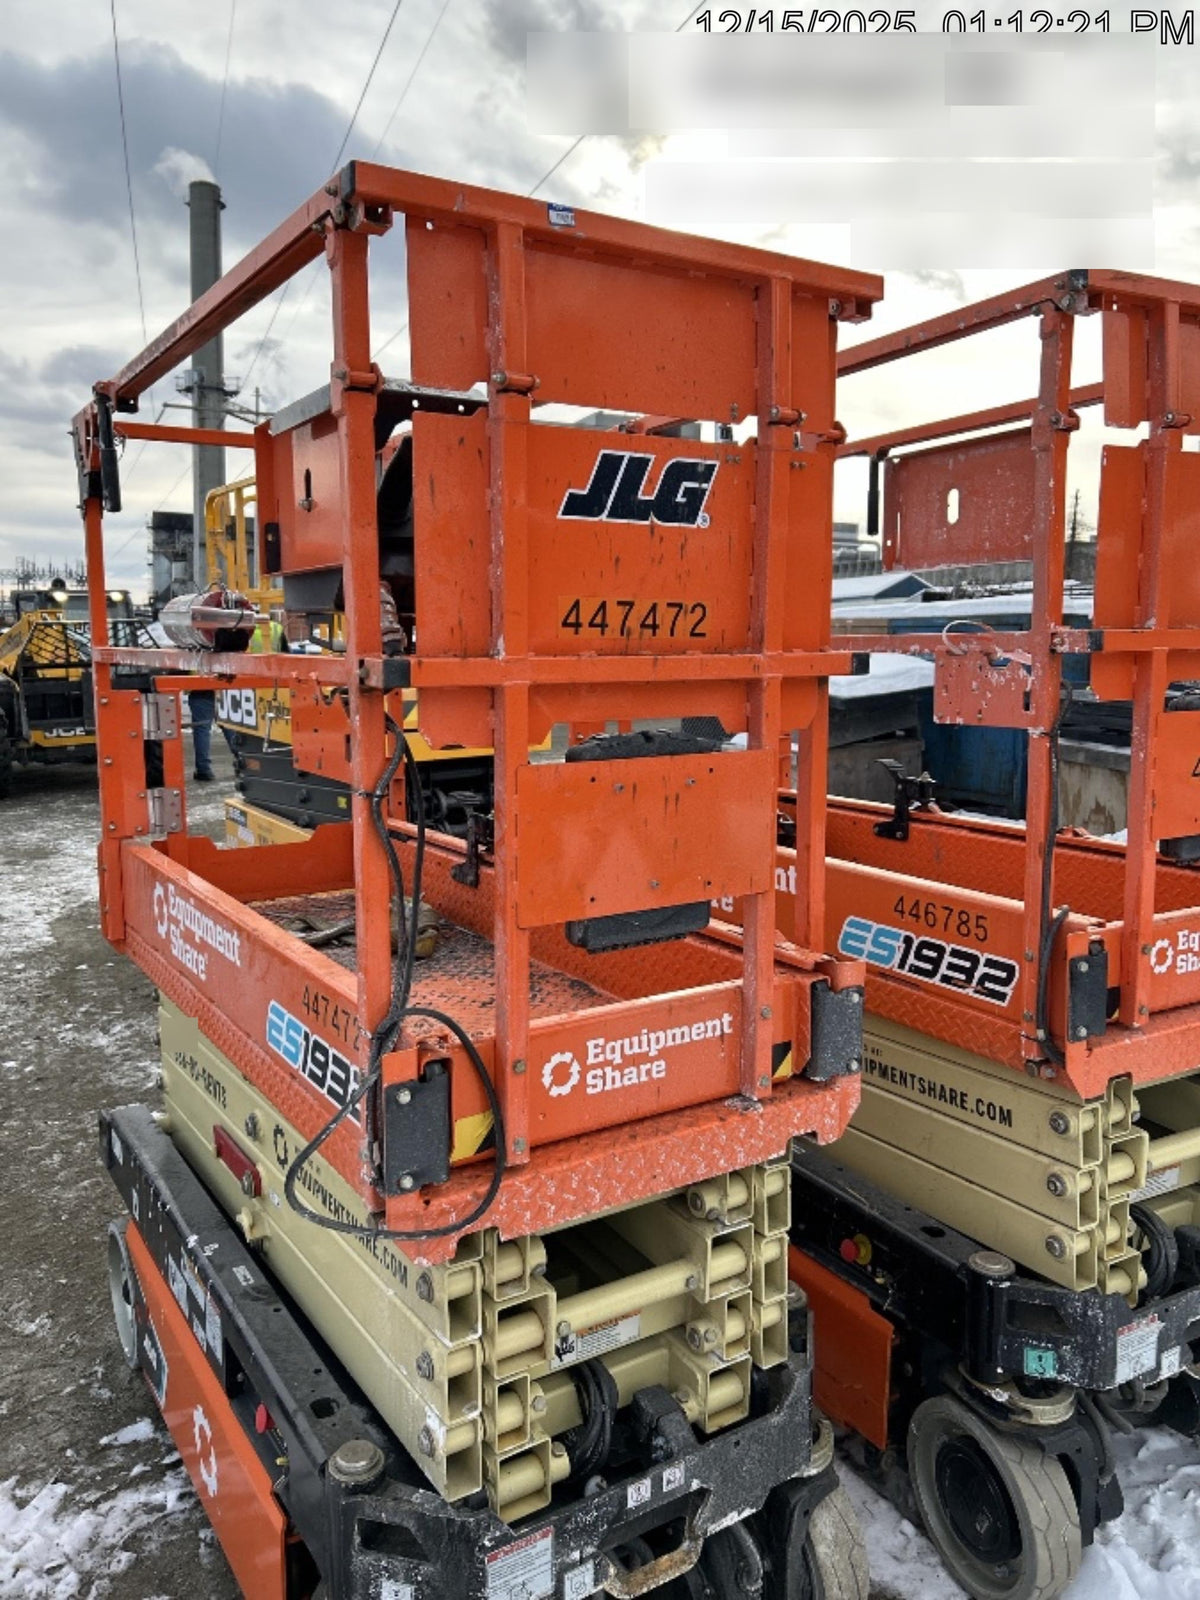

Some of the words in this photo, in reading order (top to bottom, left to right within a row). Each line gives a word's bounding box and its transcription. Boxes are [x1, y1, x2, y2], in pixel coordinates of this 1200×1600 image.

[557, 449, 720, 528] JLG
[561, 598, 707, 637] 447472
[216, 689, 258, 727] JCB
[168, 882, 241, 968] Equipment
[893, 895, 989, 942] 446785
[170, 922, 207, 982] Share
[839, 916, 1018, 1006] ES1932
[586, 1012, 733, 1065] Equipment
[586, 1058, 667, 1095] Share
[861, 1056, 1013, 1128] IPMENTSHARE.COM
